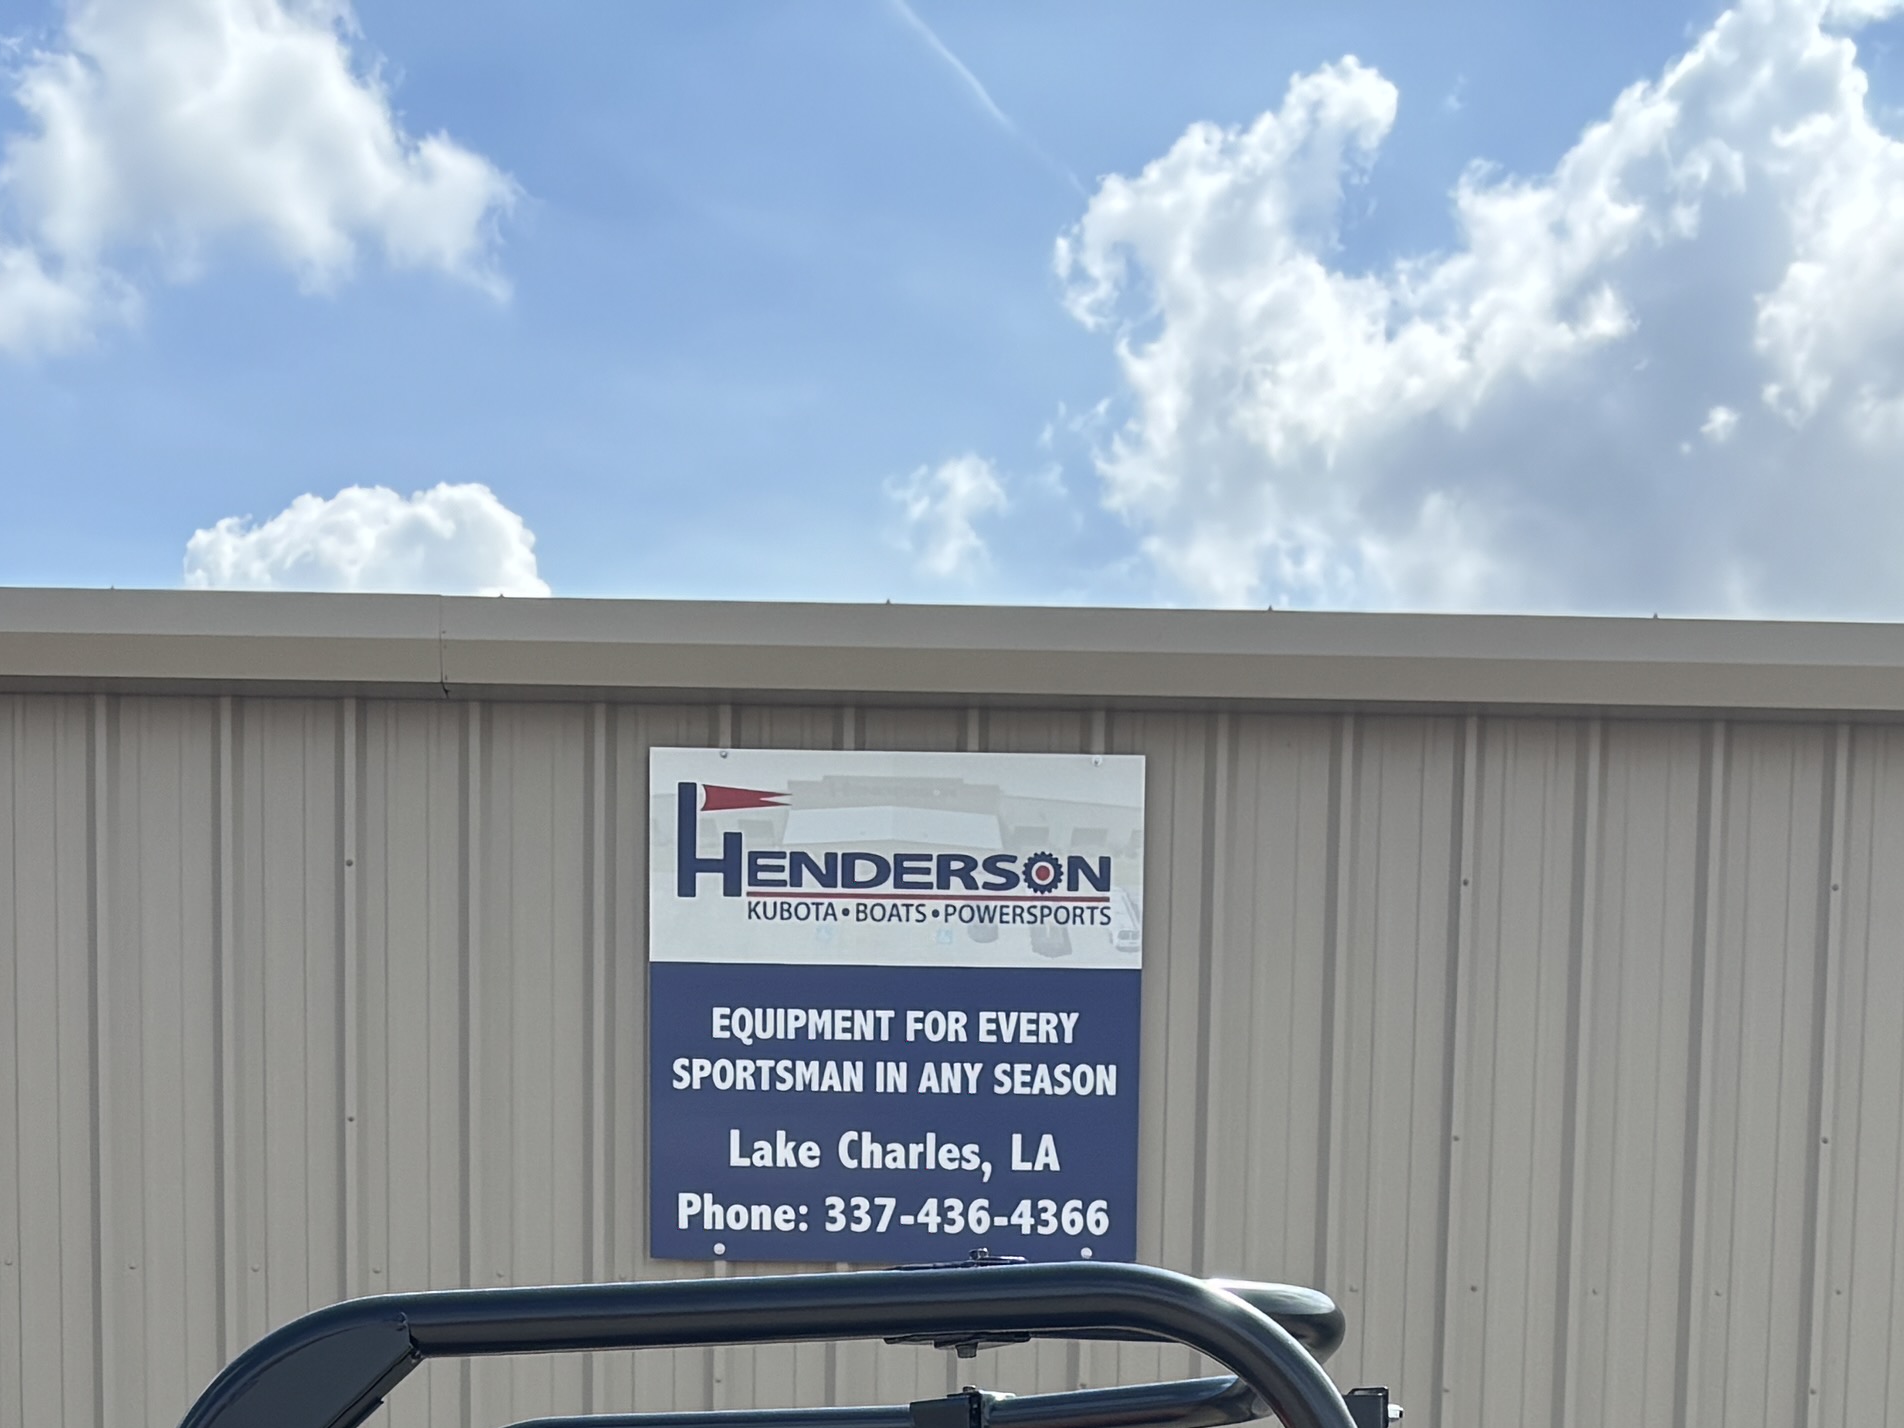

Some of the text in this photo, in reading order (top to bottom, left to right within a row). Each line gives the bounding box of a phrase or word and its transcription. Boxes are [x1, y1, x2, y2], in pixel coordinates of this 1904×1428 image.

[677, 782, 1112, 897] HENDERSON
[747, 901, 1112, 926] KUBOTA BOATS POWERSPORTS
[712, 1007, 1080, 1045] EQUIPMENT FOR EVERY
[672, 1058, 1117, 1096] SPORTSMAN IN ANY SEASON
[729, 1129, 1061, 1183] Lake Charles, LA
[677, 1193, 1110, 1236] Phone: 337-436-4366
